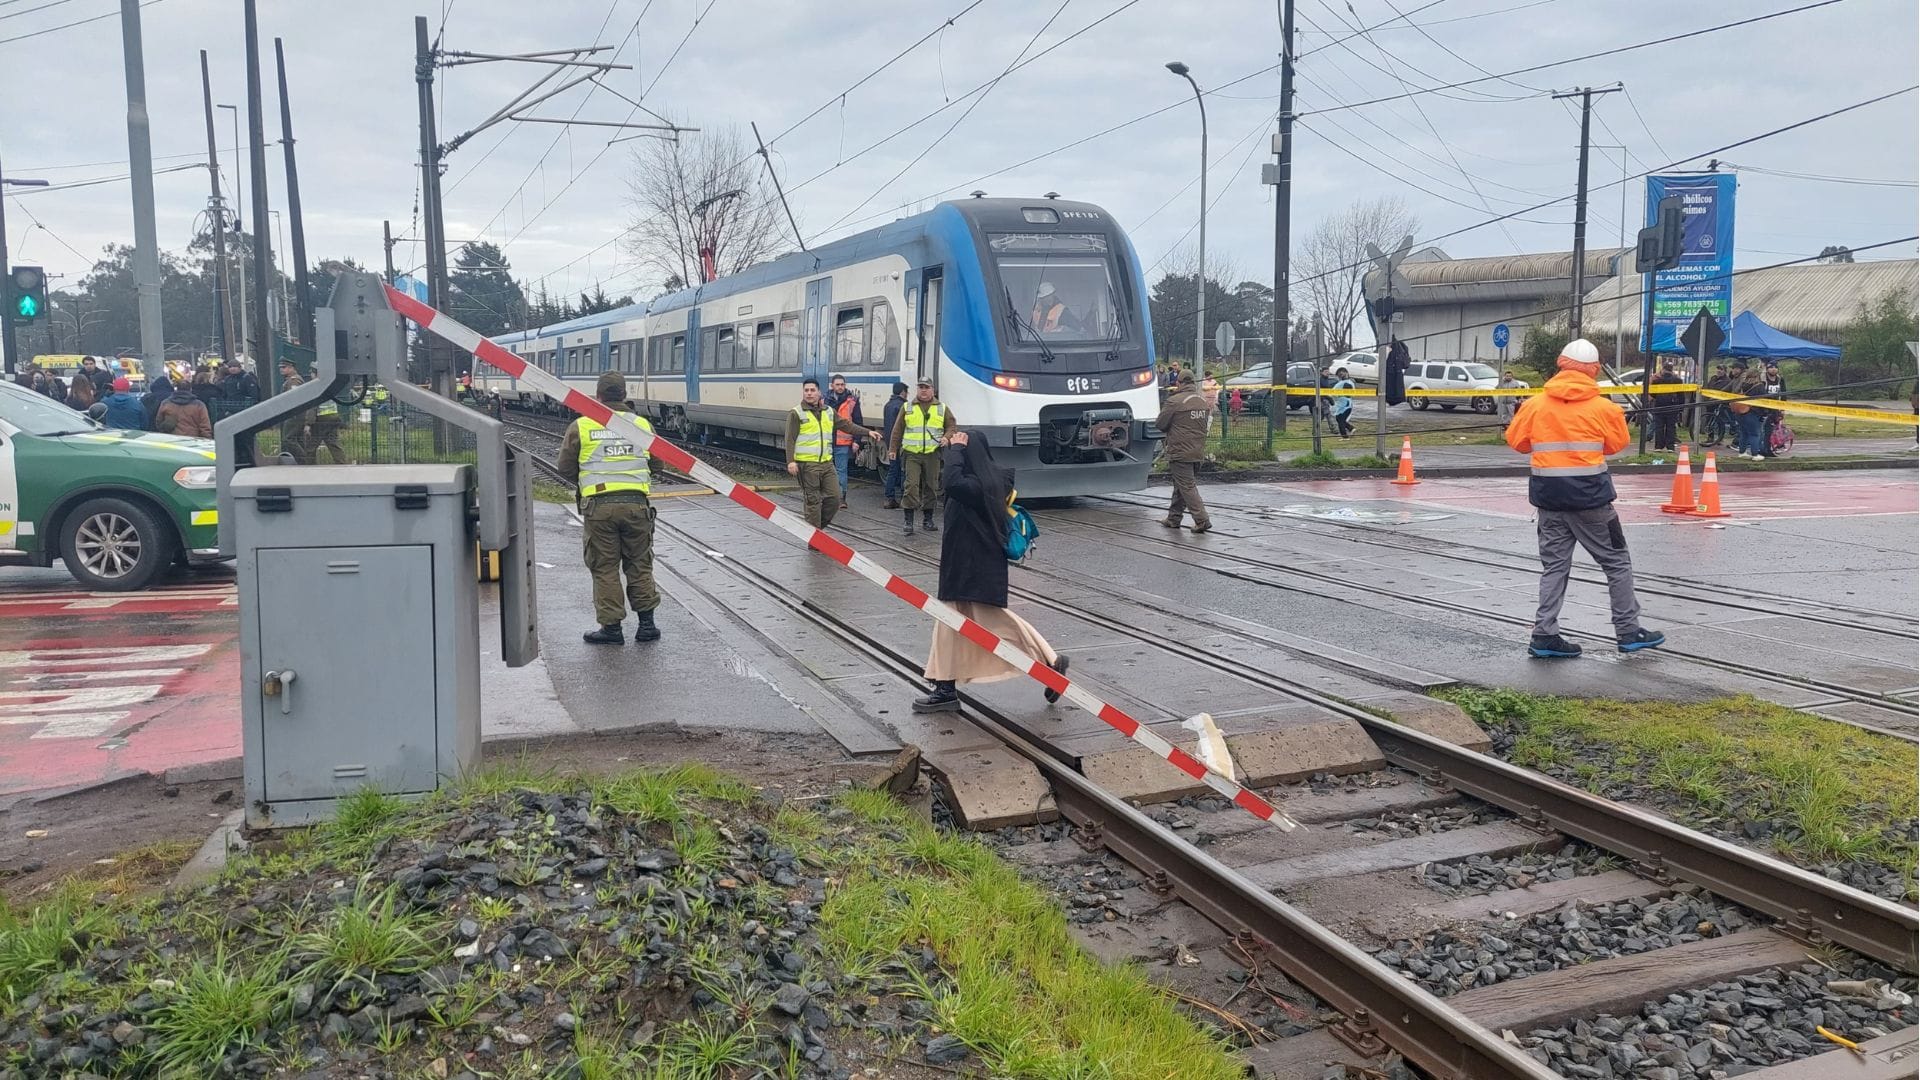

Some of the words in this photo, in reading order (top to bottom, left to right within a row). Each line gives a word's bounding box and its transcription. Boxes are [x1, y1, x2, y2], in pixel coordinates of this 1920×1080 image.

[1063, 211, 1099, 219] SFE101
[1067, 376, 1089, 394] efe
[1190, 410, 1207, 420] SIAT
[606, 446, 632, 456] SIAT
